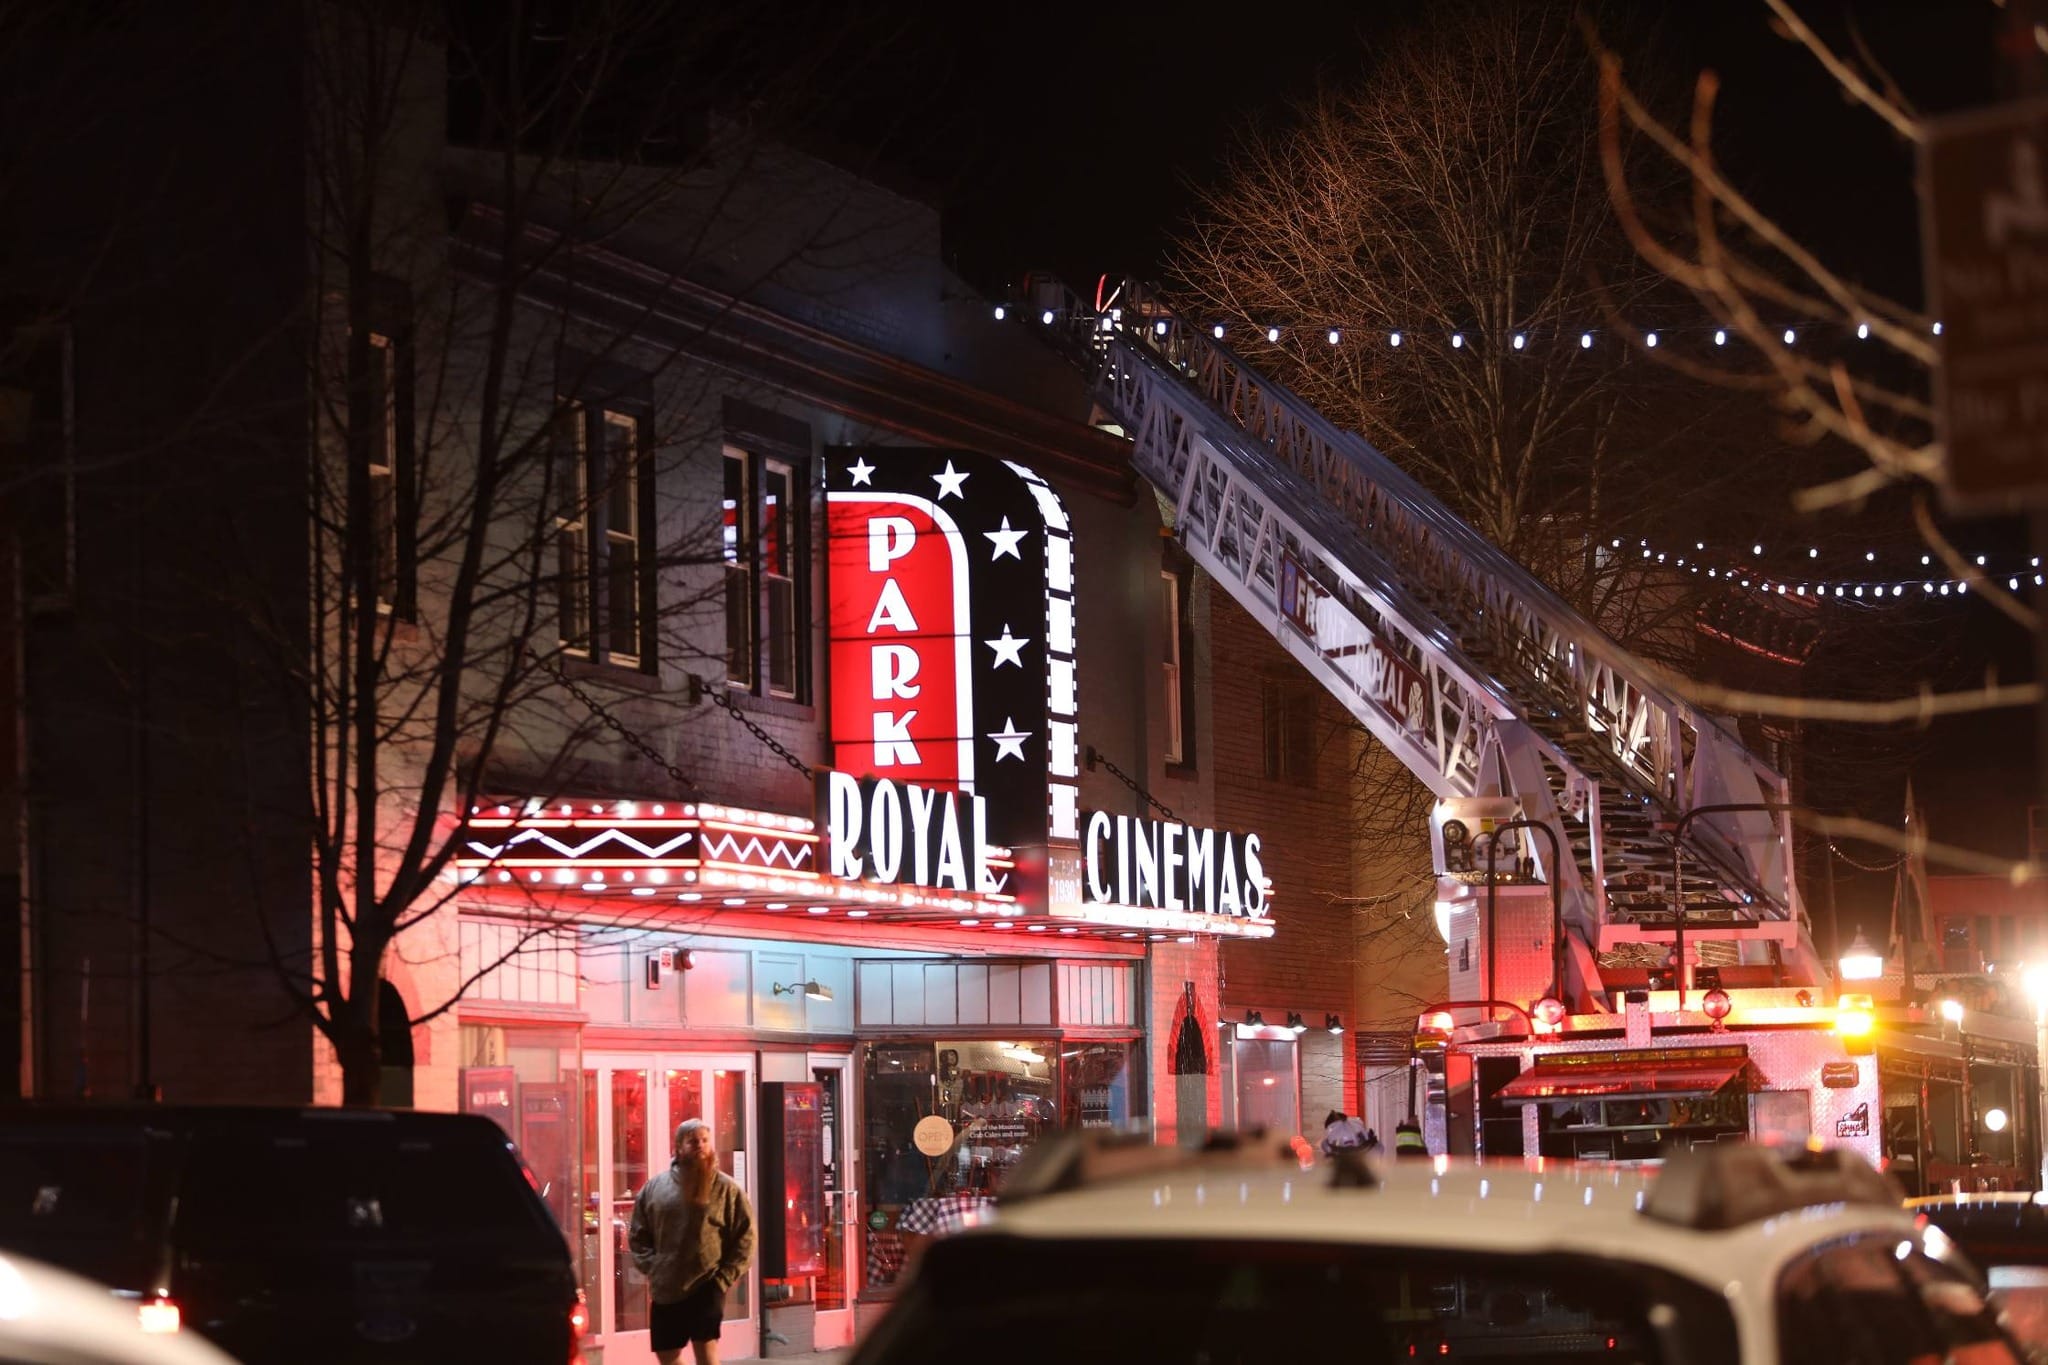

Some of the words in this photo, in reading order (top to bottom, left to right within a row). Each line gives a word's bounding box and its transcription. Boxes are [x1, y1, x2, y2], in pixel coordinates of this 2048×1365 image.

[866, 516, 922, 767] PARK
[1356, 634, 1407, 718] ROYAL
[829, 771, 998, 893] ROYAL
[1086, 810, 1266, 918] CINEMAS
